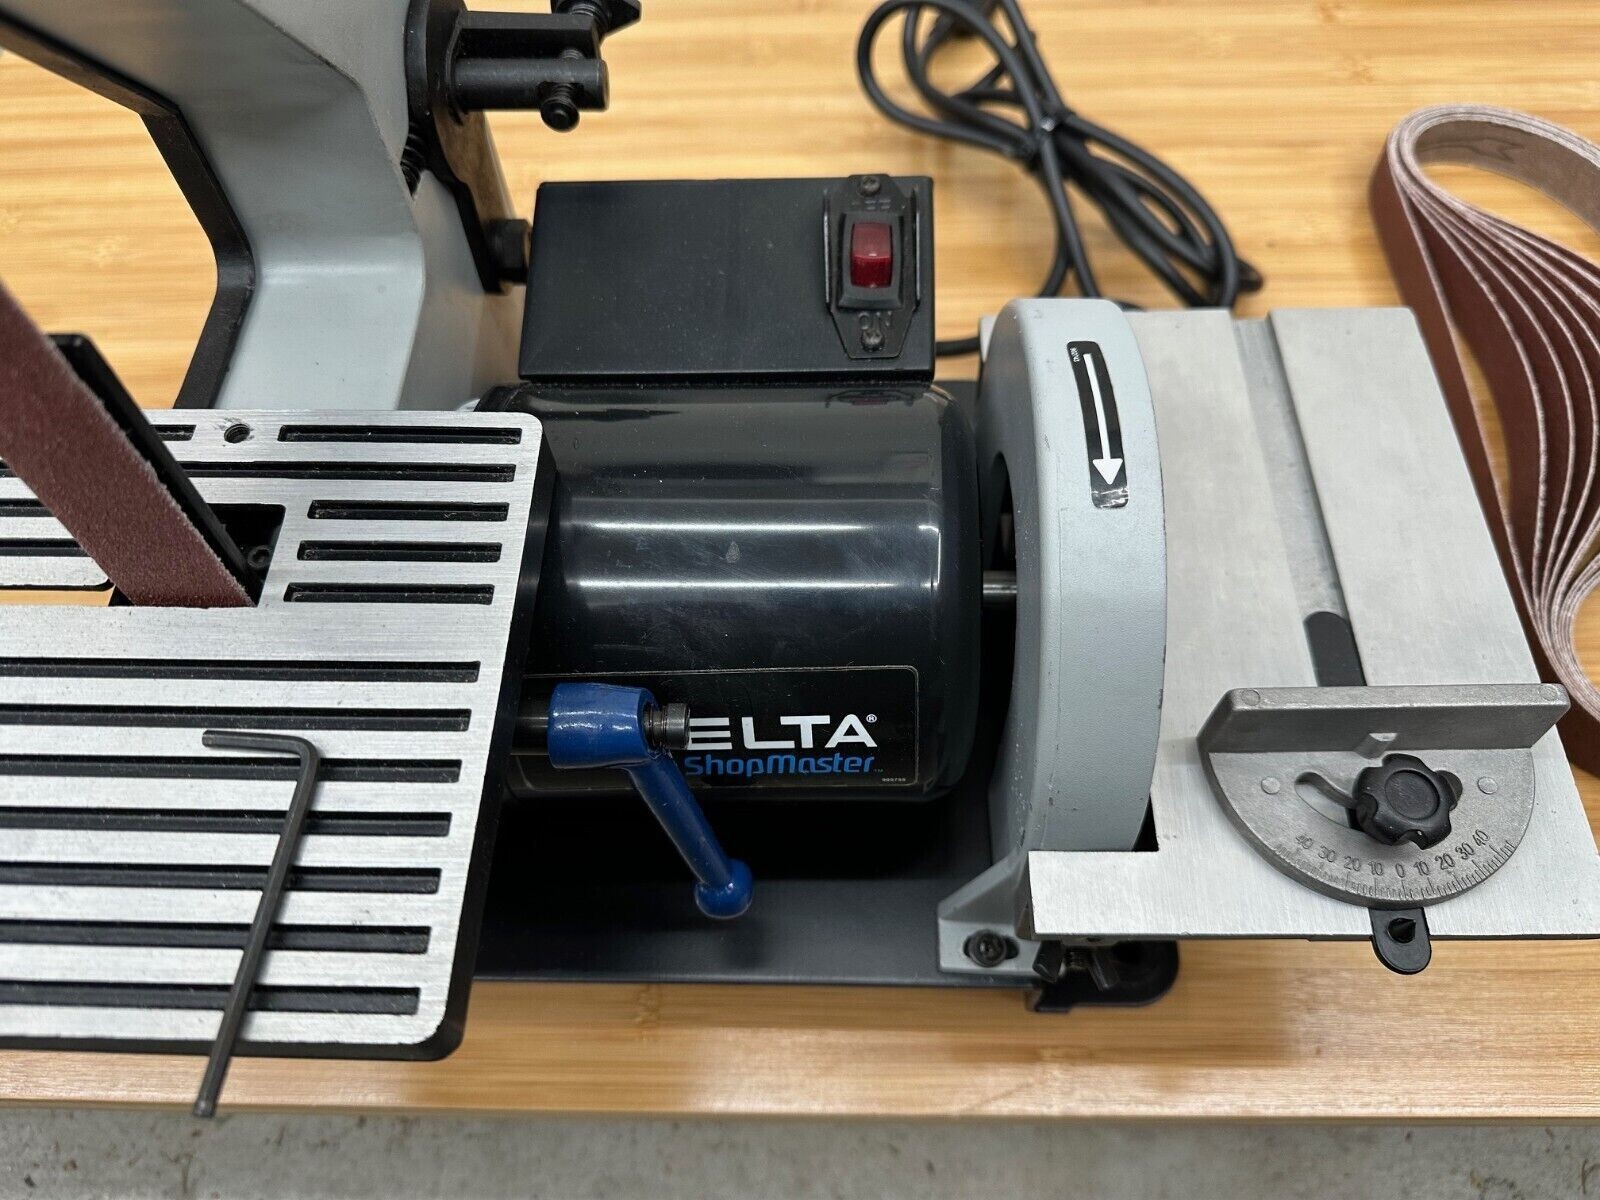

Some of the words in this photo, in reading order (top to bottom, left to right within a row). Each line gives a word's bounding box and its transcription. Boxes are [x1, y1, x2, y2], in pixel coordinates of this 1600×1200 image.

[684, 752, 875, 777] ShopMaster
[1295, 833, 1313, 850] 40
[1318, 845, 1337, 863] 30
[1343, 856, 1361, 872] 20
[1368, 861, 1384, 876] 10
[1395, 864, 1405, 878] 0
[1413, 860, 1430, 876] 10
[1434, 852, 1455, 871] 20
[1455, 842, 1475, 860] 30
[1475, 829, 1491, 847] 40
